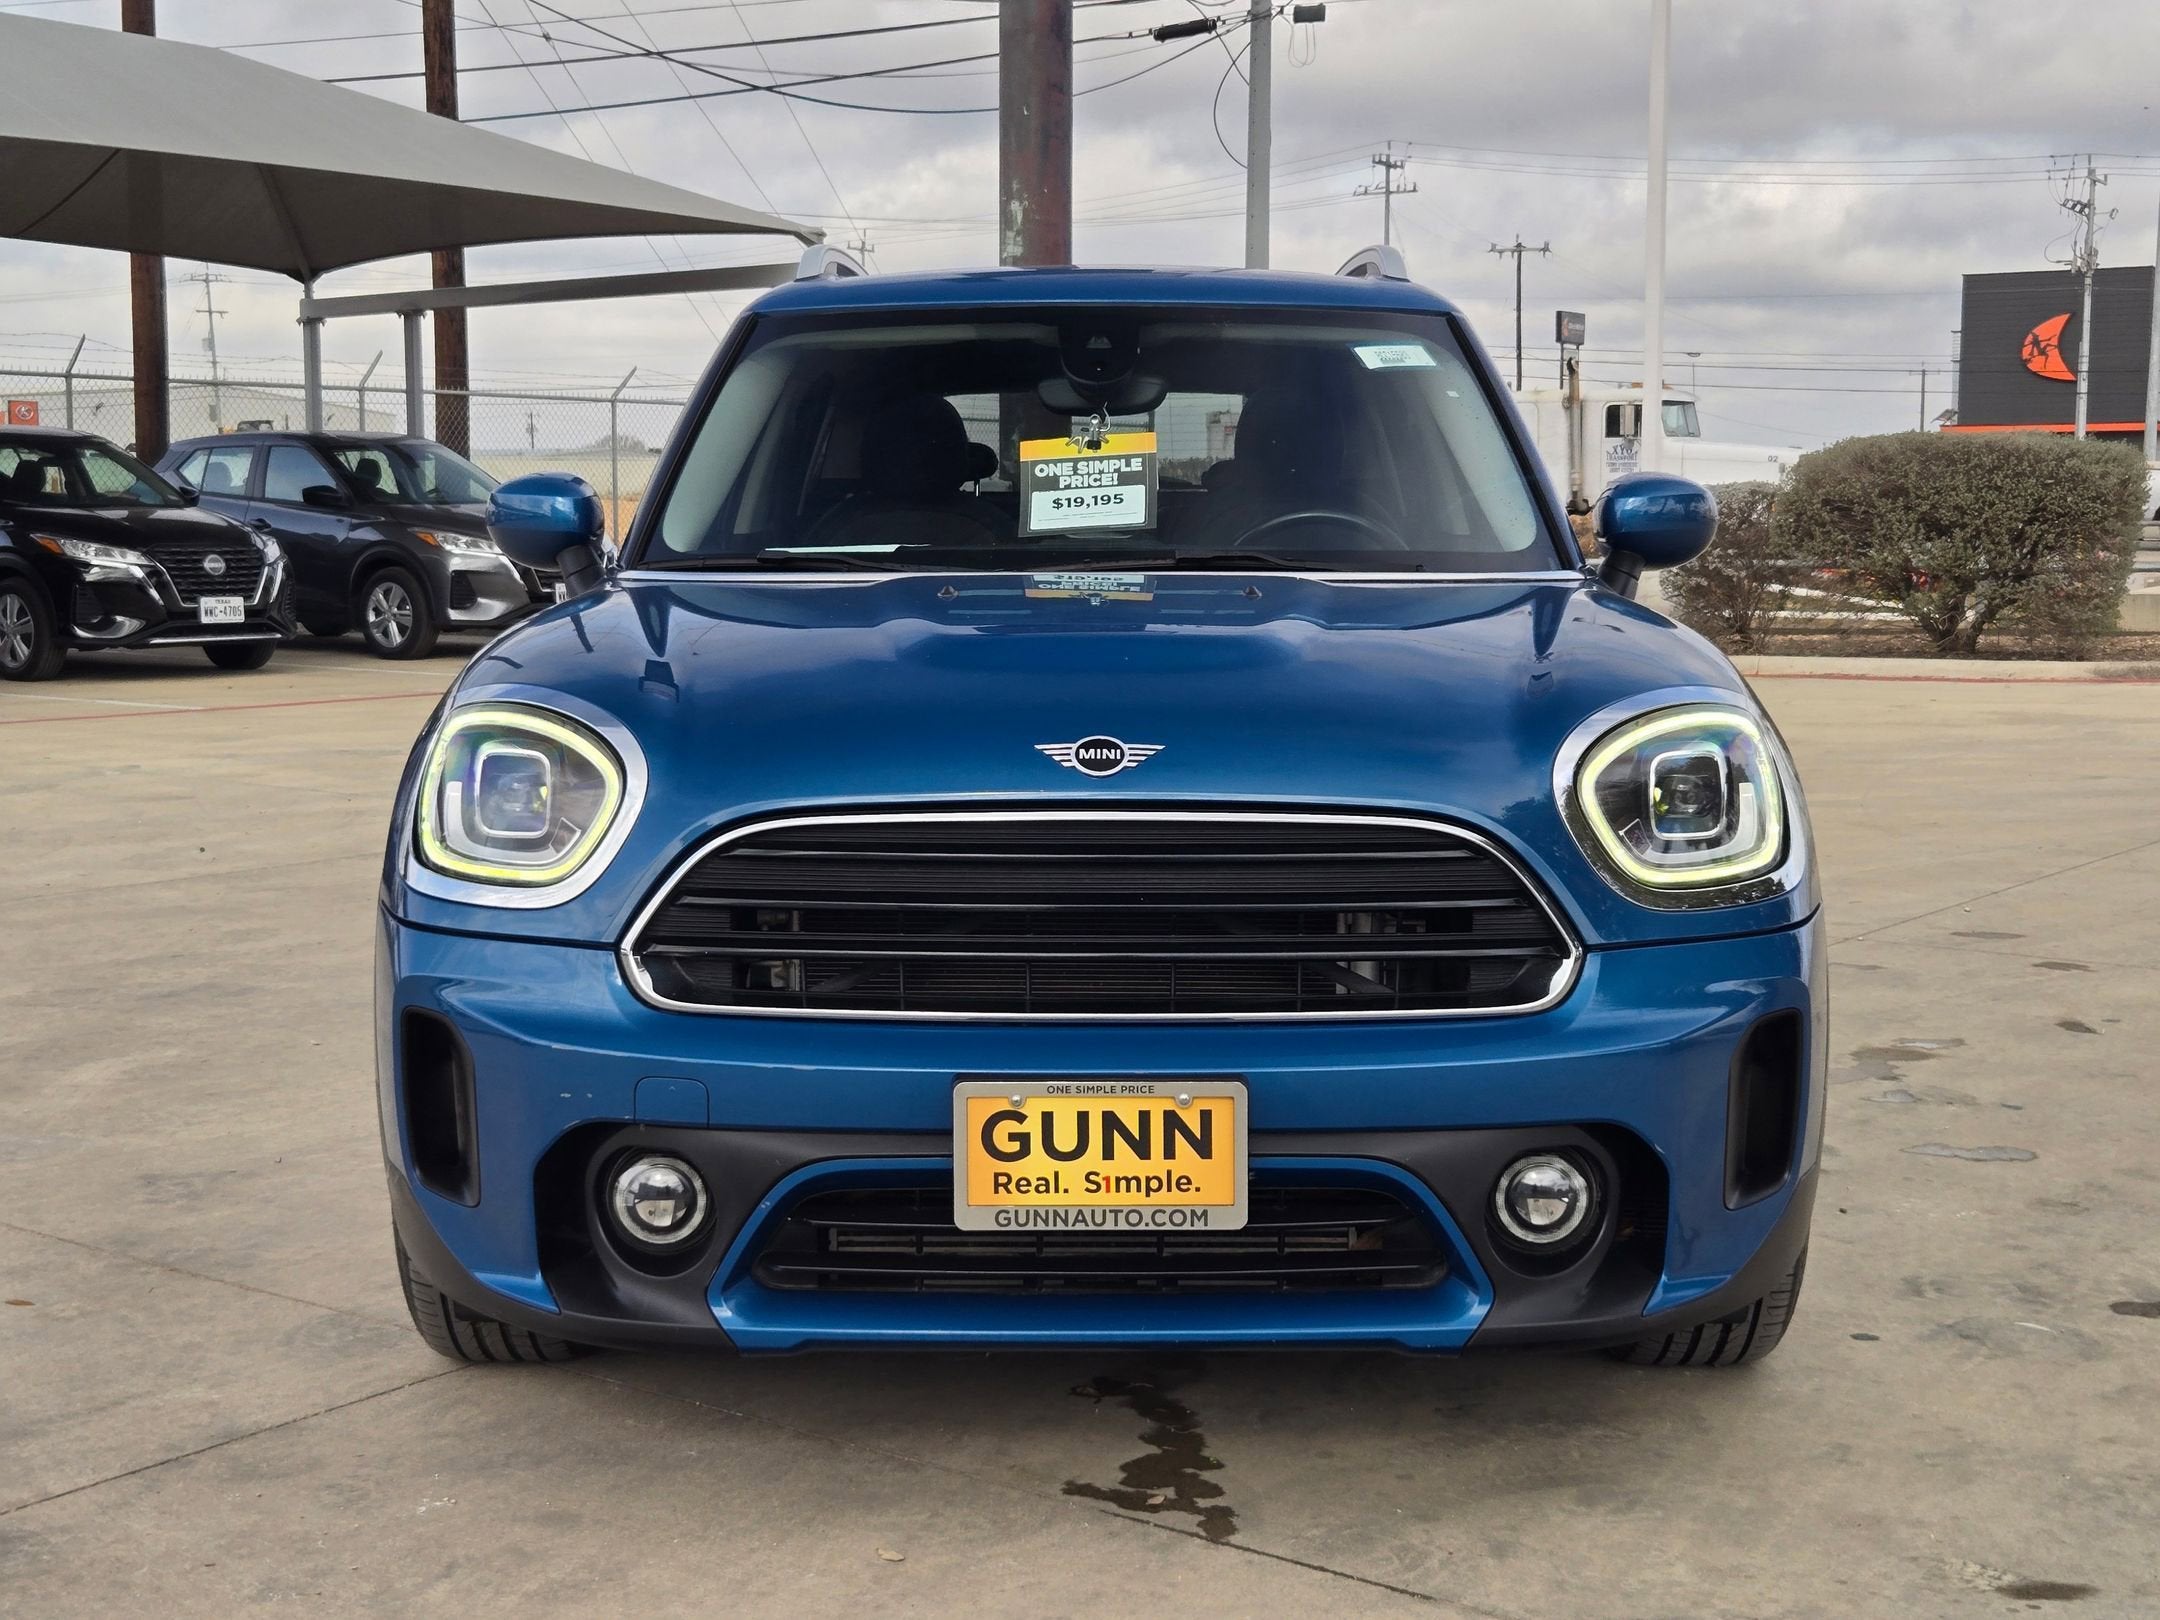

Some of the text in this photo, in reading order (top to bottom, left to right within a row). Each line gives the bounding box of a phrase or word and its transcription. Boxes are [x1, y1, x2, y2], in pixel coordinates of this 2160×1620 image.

[1034, 457, 1143, 478] ONE SIMPLE
[1767, 455, 1778, 463] 02
[1059, 472, 1119, 489] PRICE!
[1052, 493, 1124, 511] $19,195
[1079, 748, 1121, 760] MINI
[1046, 1085, 1155, 1094] ONE SIMPLE PRICE
[980, 1109, 1213, 1162] GUNN
[993, 1170, 1069, 1194] Real.
[994, 1208, 1209, 1228] GUNNAUTO.COM
